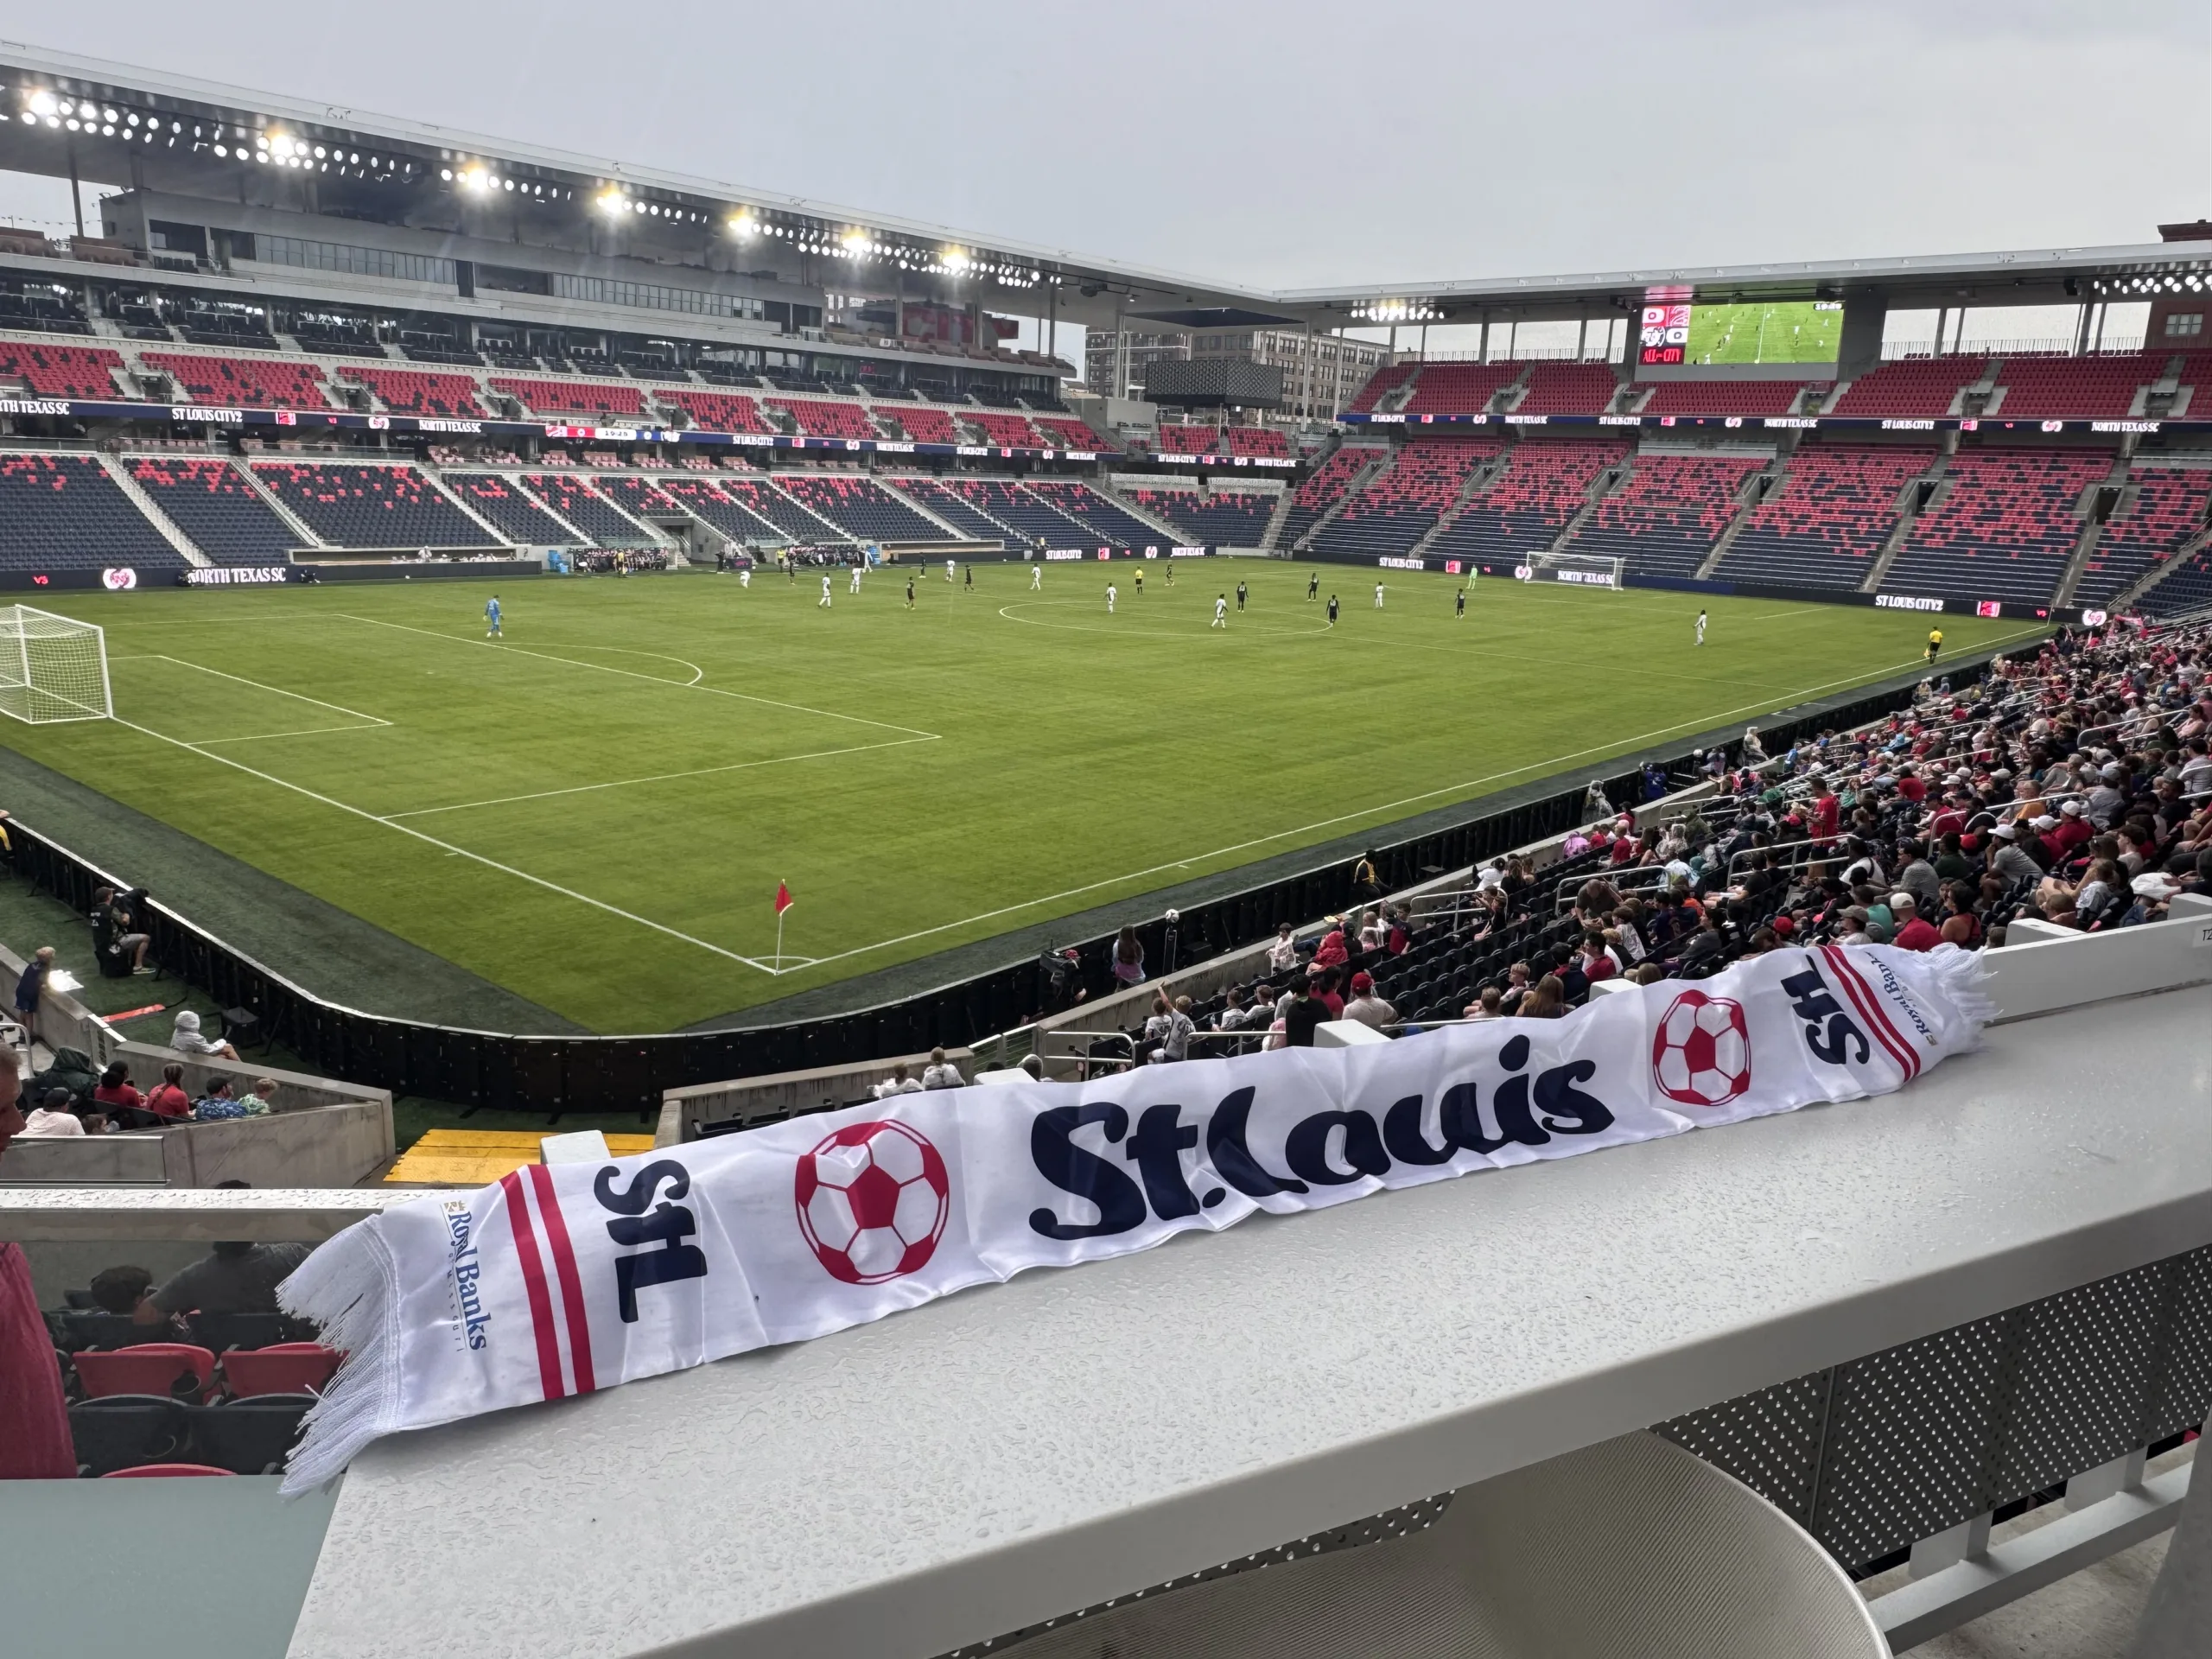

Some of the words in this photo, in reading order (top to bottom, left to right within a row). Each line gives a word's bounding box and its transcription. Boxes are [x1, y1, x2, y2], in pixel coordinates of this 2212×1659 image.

[19, 401, 55, 415] TEXAS
[55, 402, 69, 415] SC
[172, 408, 186, 420] ST
[186, 408, 214, 422] LOUIS
[231, 568, 270, 583] TEXAS
[270, 567, 287, 582] SC
[1875, 594, 1889, 607] ST
[1888, 595, 1916, 609] LOUIS
[448, 1211, 478, 1264] Royal
[455, 1261, 492, 1352] Banks
